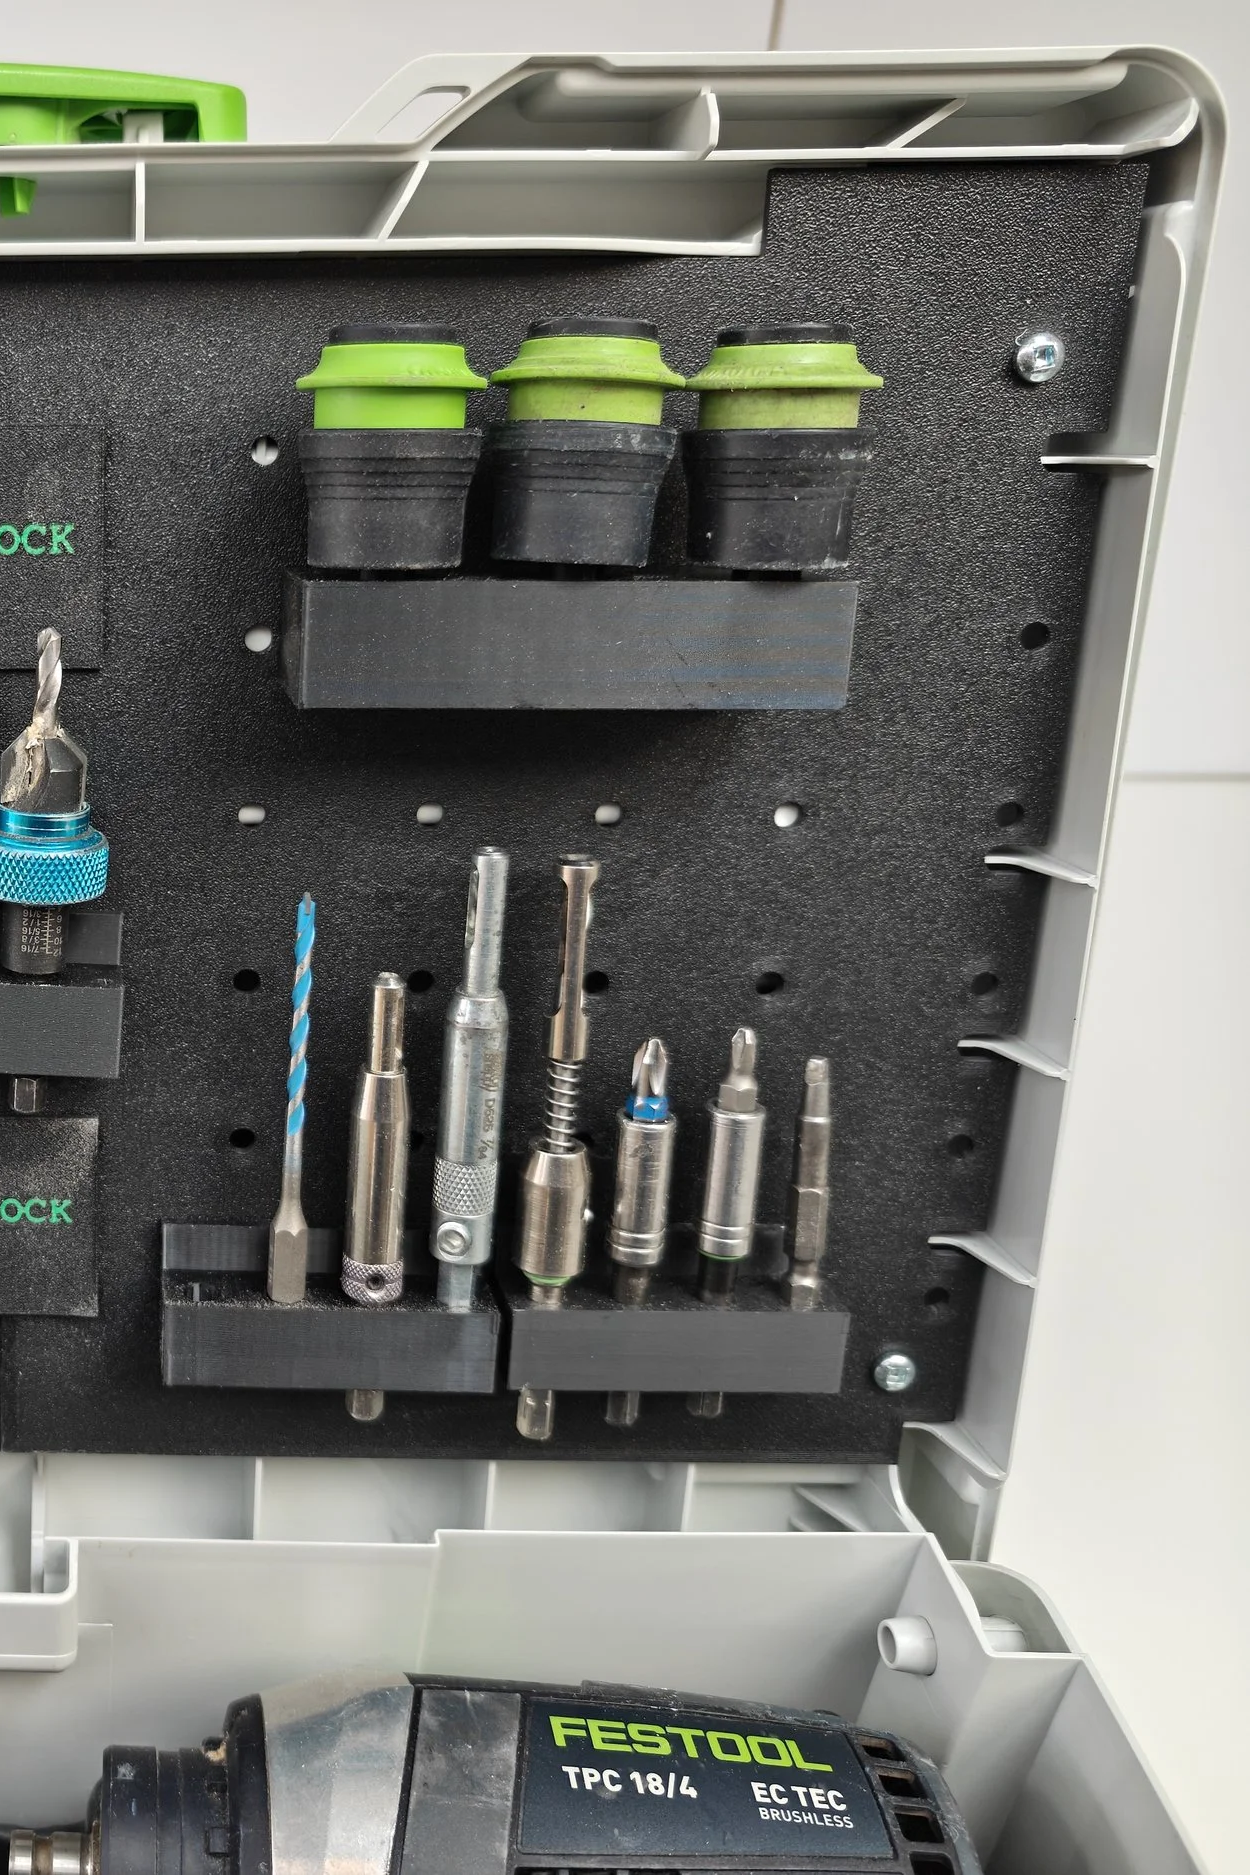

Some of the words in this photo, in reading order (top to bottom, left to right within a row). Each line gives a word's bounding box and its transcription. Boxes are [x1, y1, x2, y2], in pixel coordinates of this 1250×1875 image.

[549, 1715, 834, 1773] FESTOOL
[561, 1765, 623, 1792] TPC
[629, 1770, 699, 1800] 18/4
[751, 1781, 789, 1805] EC
[791, 1786, 848, 1811] TEC
[758, 1806, 855, 1829] BRUSHLESS
